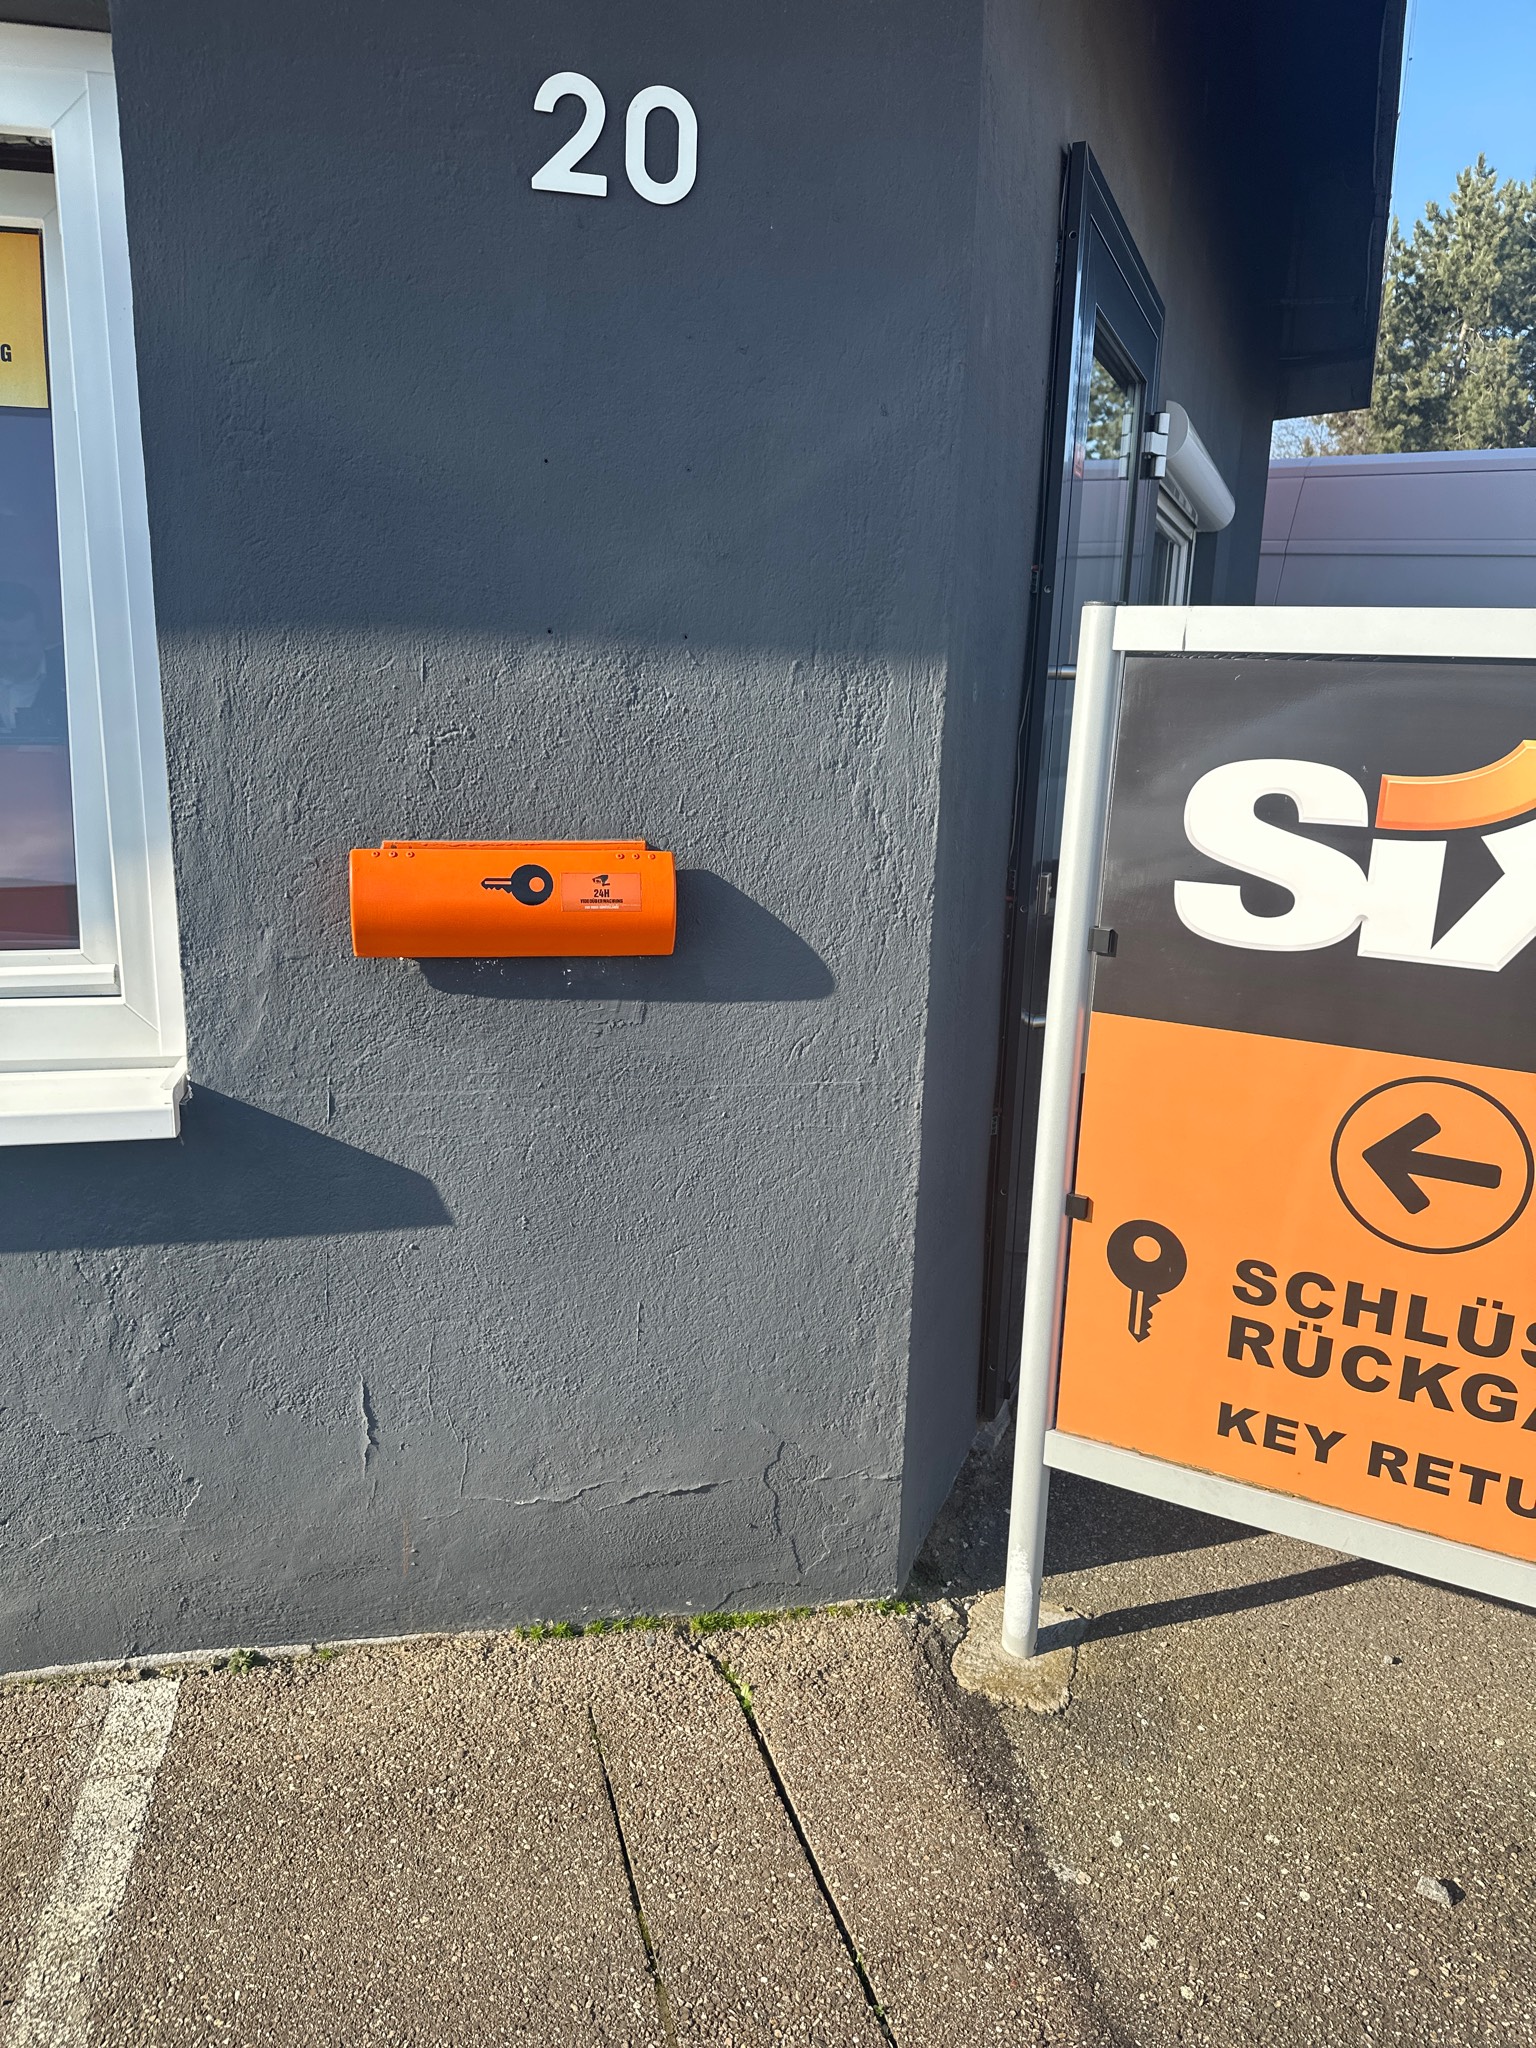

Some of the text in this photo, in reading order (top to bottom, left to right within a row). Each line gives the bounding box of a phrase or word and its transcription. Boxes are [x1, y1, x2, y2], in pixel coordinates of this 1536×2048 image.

[531, 71, 698, 205] 20
[593, 888, 610, 898] 24H
[1227, 1314, 1536, 1434] RÜCKG
[1216, 1401, 1347, 1465] KEY
